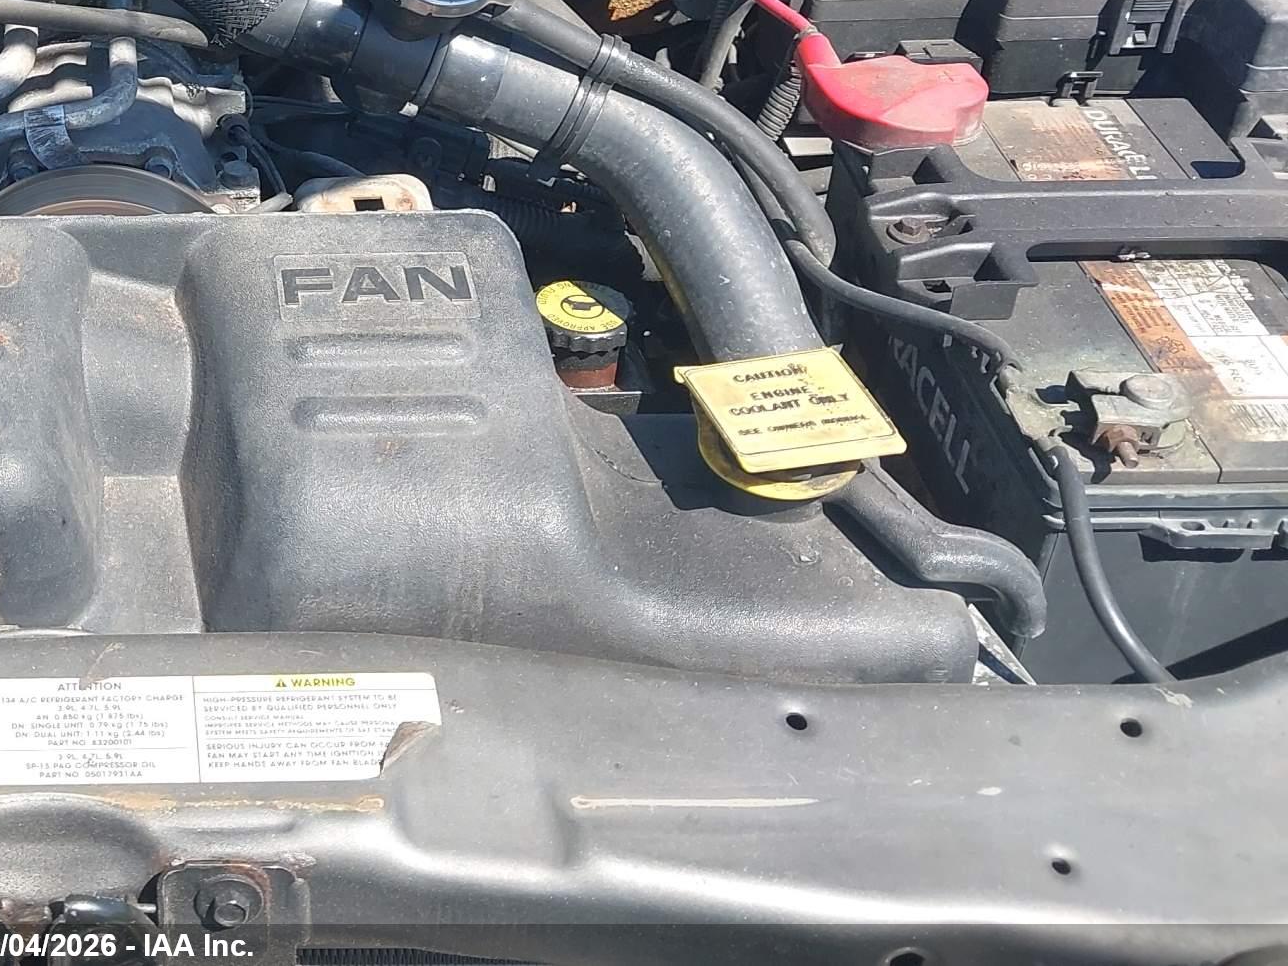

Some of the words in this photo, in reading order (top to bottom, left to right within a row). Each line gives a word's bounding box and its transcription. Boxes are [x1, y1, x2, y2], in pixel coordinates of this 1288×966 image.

[280, 265, 473, 307] FAN
[749, 385, 813, 402] ENGINE
[728, 398, 801, 417] COOLANT
[57, 682, 122, 691] ATTNTION
[290, 677, 356, 687] WARNING
[31, 722, 61, 730] SINGLE
[206, 742, 245, 750] SERIOUS
[248, 741, 283, 749] INJURY
[252, 750, 280, 758] START
[234, 760, 267, 768] HANDS
[270, 759, 297, 767] AWAY
